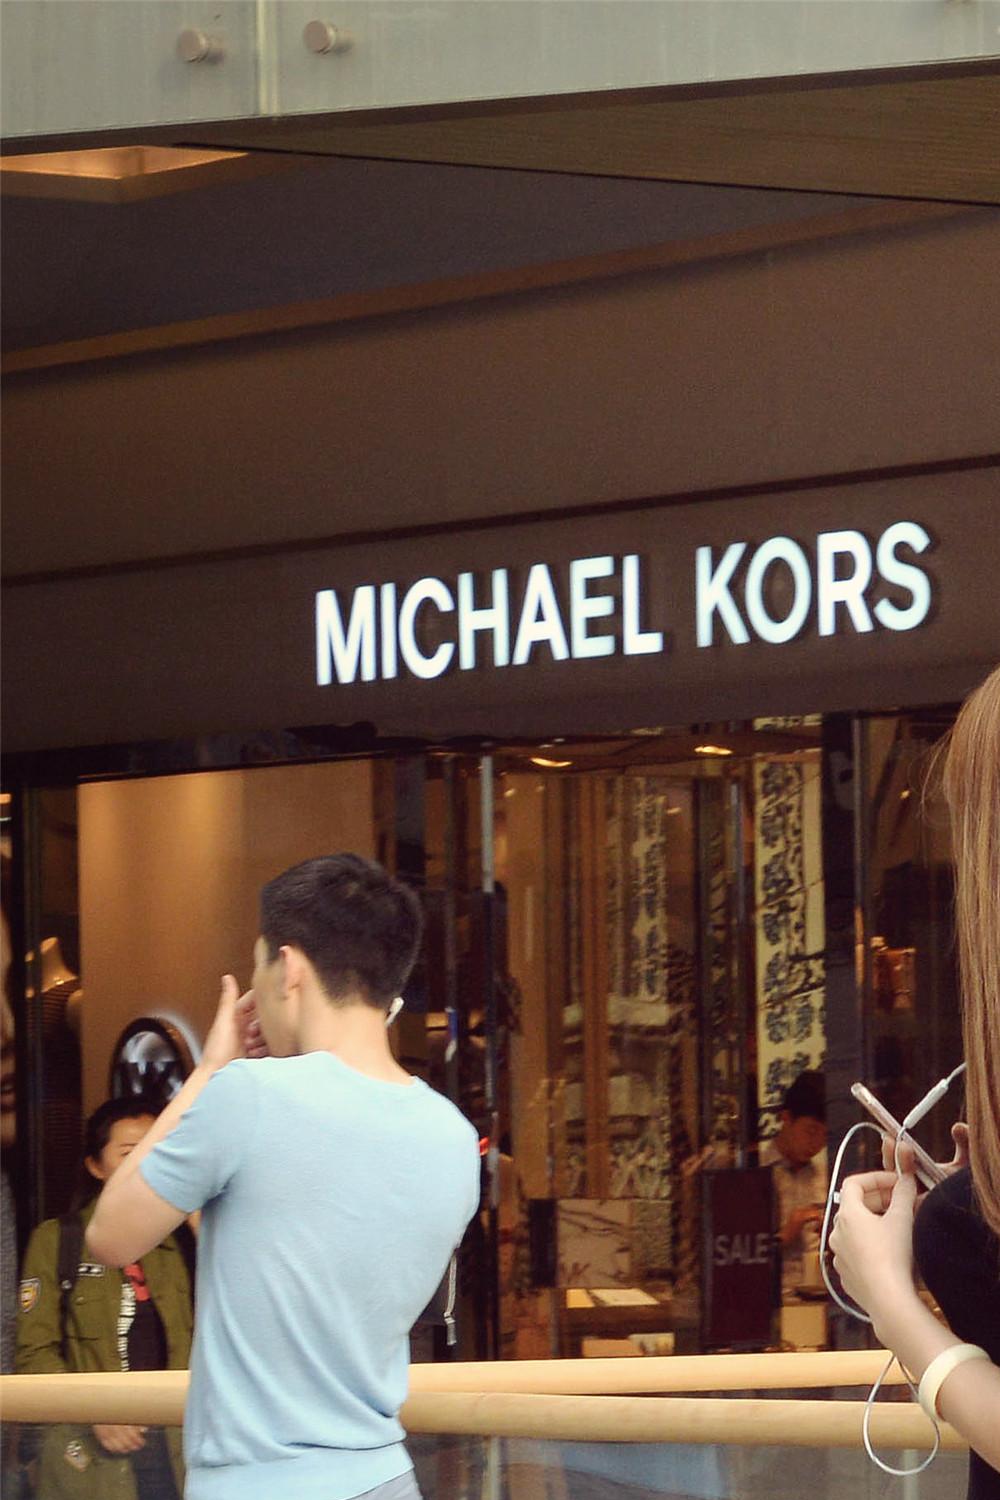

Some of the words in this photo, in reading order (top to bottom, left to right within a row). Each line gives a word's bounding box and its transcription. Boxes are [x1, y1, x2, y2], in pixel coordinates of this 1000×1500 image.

[315, 554, 663, 686] MICHAEL
[696, 521, 931, 648] KORS
[714, 1232, 769, 1266] SALE
